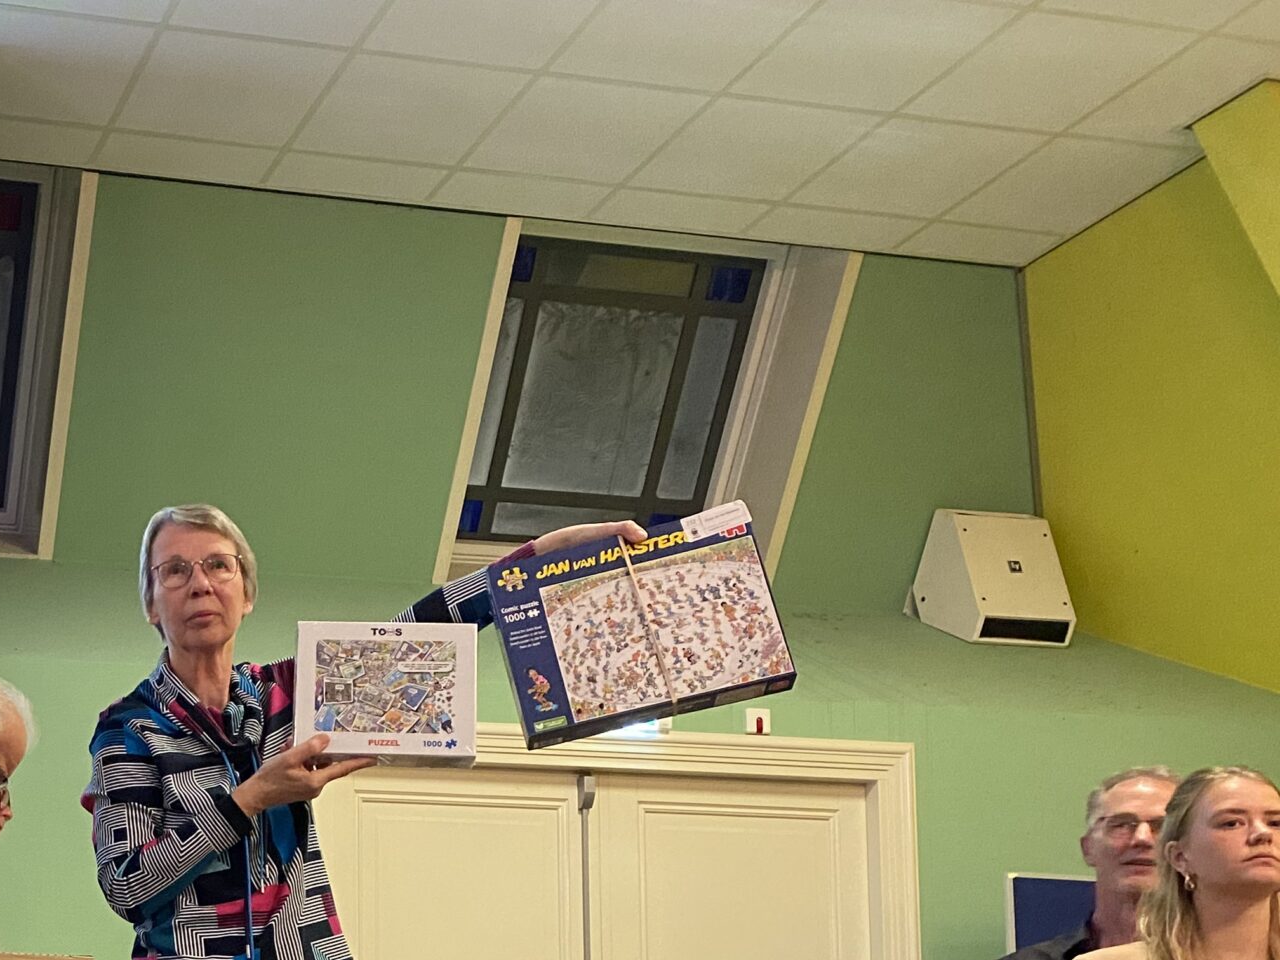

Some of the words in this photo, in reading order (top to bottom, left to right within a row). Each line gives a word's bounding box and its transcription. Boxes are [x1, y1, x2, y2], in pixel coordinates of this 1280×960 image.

[535, 559, 570, 580] JAN
[573, 556, 596, 571] VAN
[599, 529, 690, 564] HAASTER
[504, 611, 526, 623] 1000
[368, 739, 400, 747] PUZZEL
[423, 740, 443, 748] 1000
